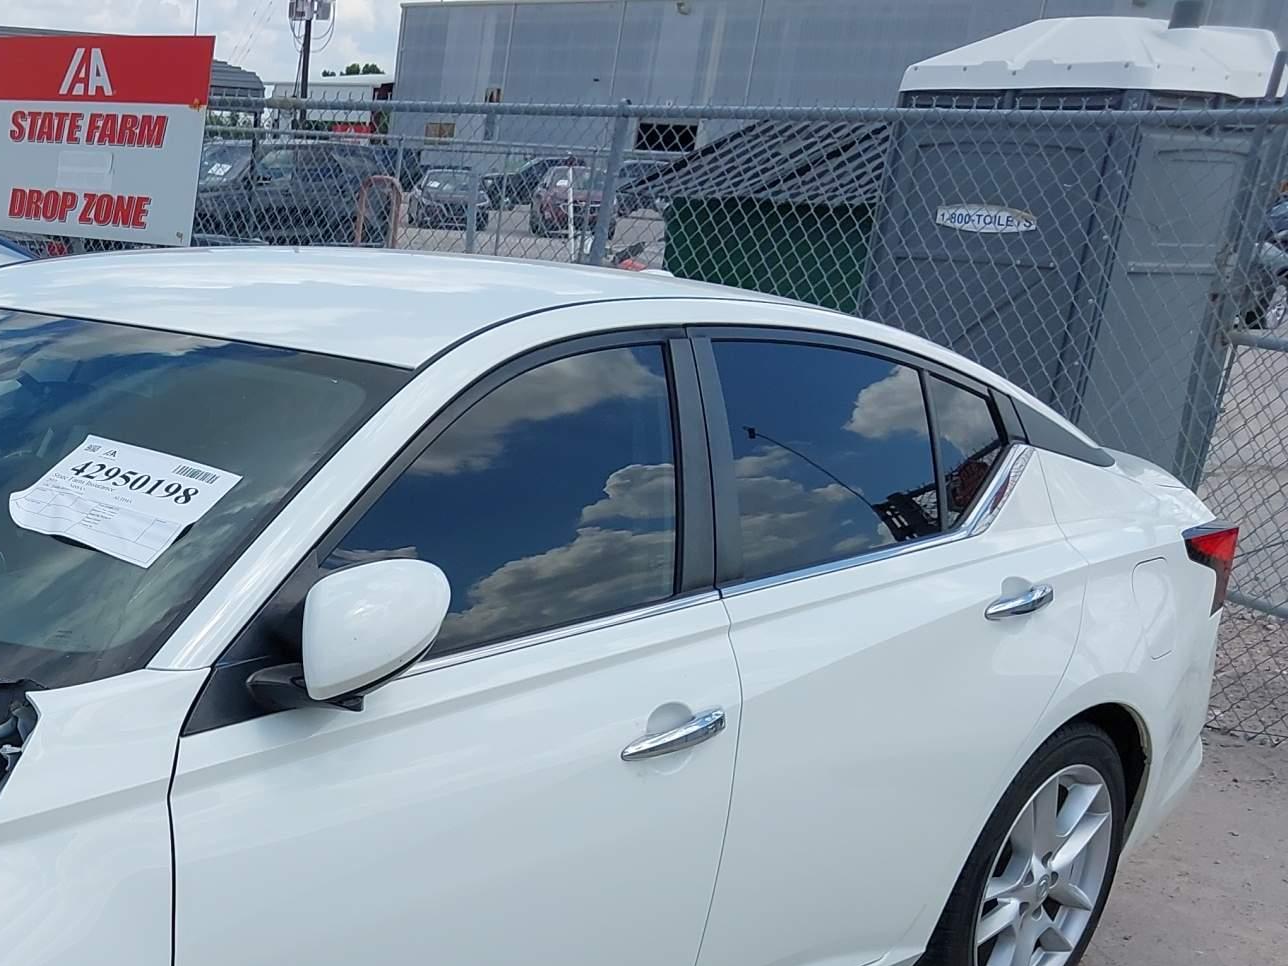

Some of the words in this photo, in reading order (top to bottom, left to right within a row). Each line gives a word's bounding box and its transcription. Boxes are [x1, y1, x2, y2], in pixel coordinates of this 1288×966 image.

[9, 110, 82, 144] STATE
[85, 113, 168, 148] FARM
[8, 188, 78, 223] DROP
[78, 193, 152, 229] ZONE
[70, 460, 200, 505] 42950198
